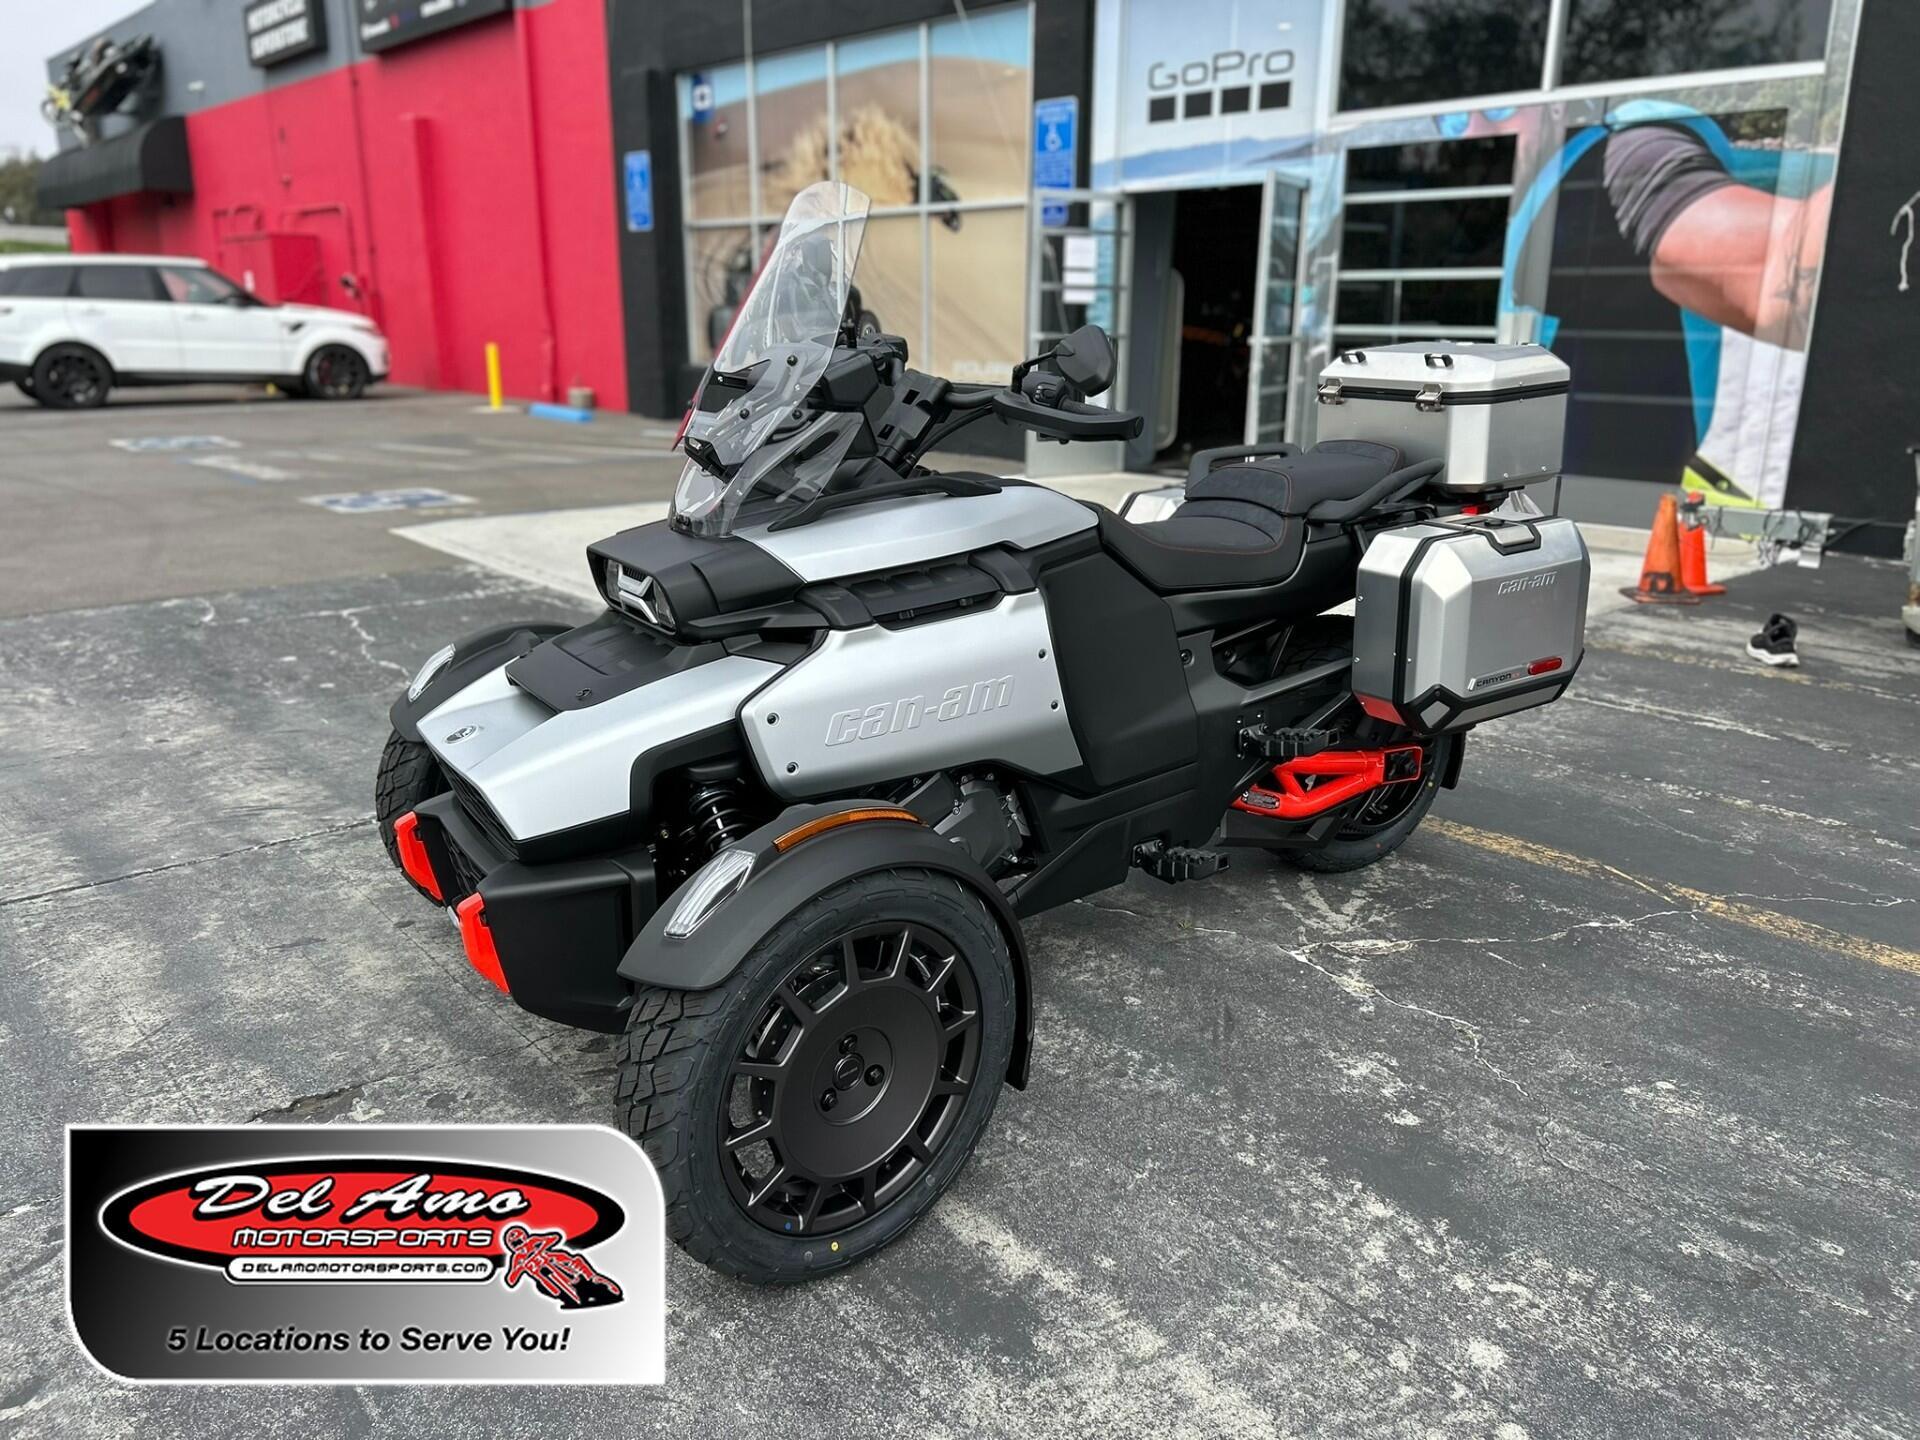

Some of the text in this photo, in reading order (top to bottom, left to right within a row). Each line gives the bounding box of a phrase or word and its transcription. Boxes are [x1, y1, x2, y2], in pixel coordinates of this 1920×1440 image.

[1148, 49, 1295, 91] GoPro
[1497, 571, 1557, 596] can-am
[825, 674, 1015, 747] can-am
